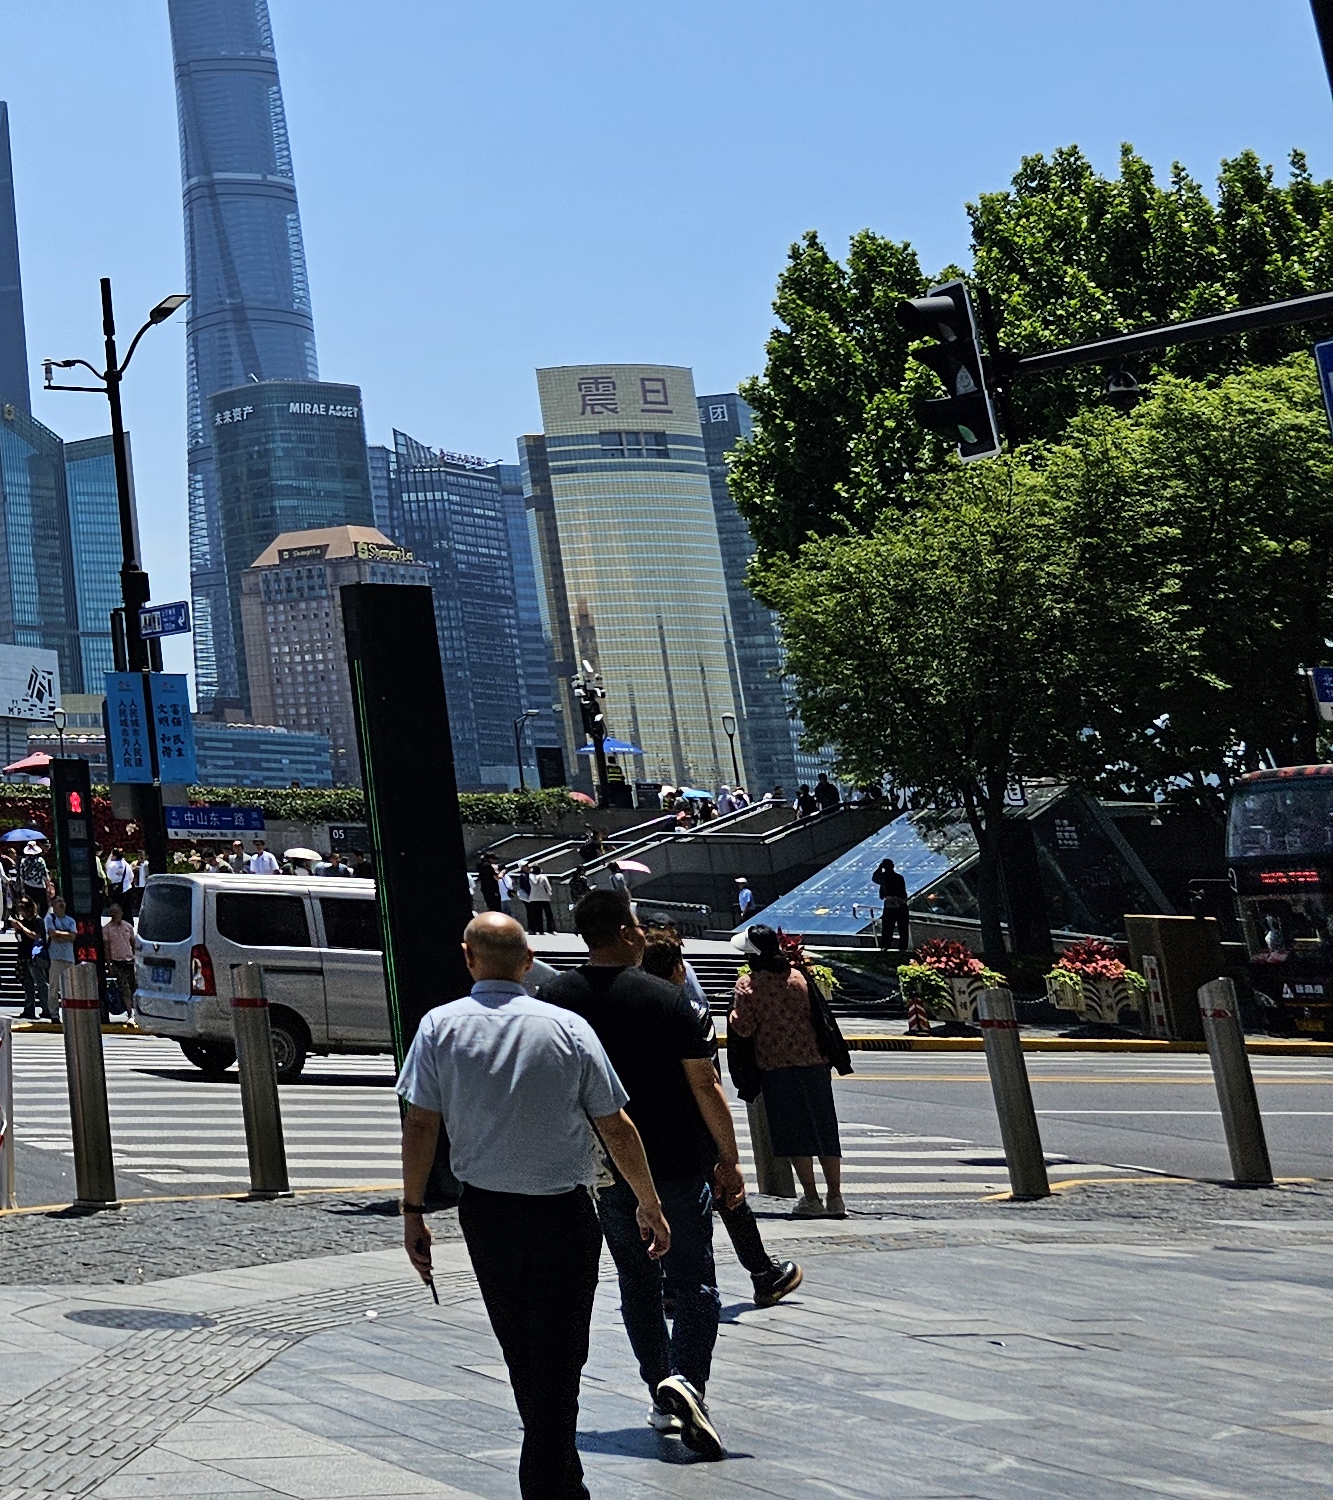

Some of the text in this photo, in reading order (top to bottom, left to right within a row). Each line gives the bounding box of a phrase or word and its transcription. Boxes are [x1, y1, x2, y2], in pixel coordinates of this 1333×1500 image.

[577, 376, 673, 416] 震旦
[214, 405, 254, 426] 未来资产
[289, 402, 359, 418] MIRAE ASSET
[184, 811, 245, 826] 中山东一路
[187, 830, 218, 839] Zhongshan
[333, 829, 345, 839] 05
